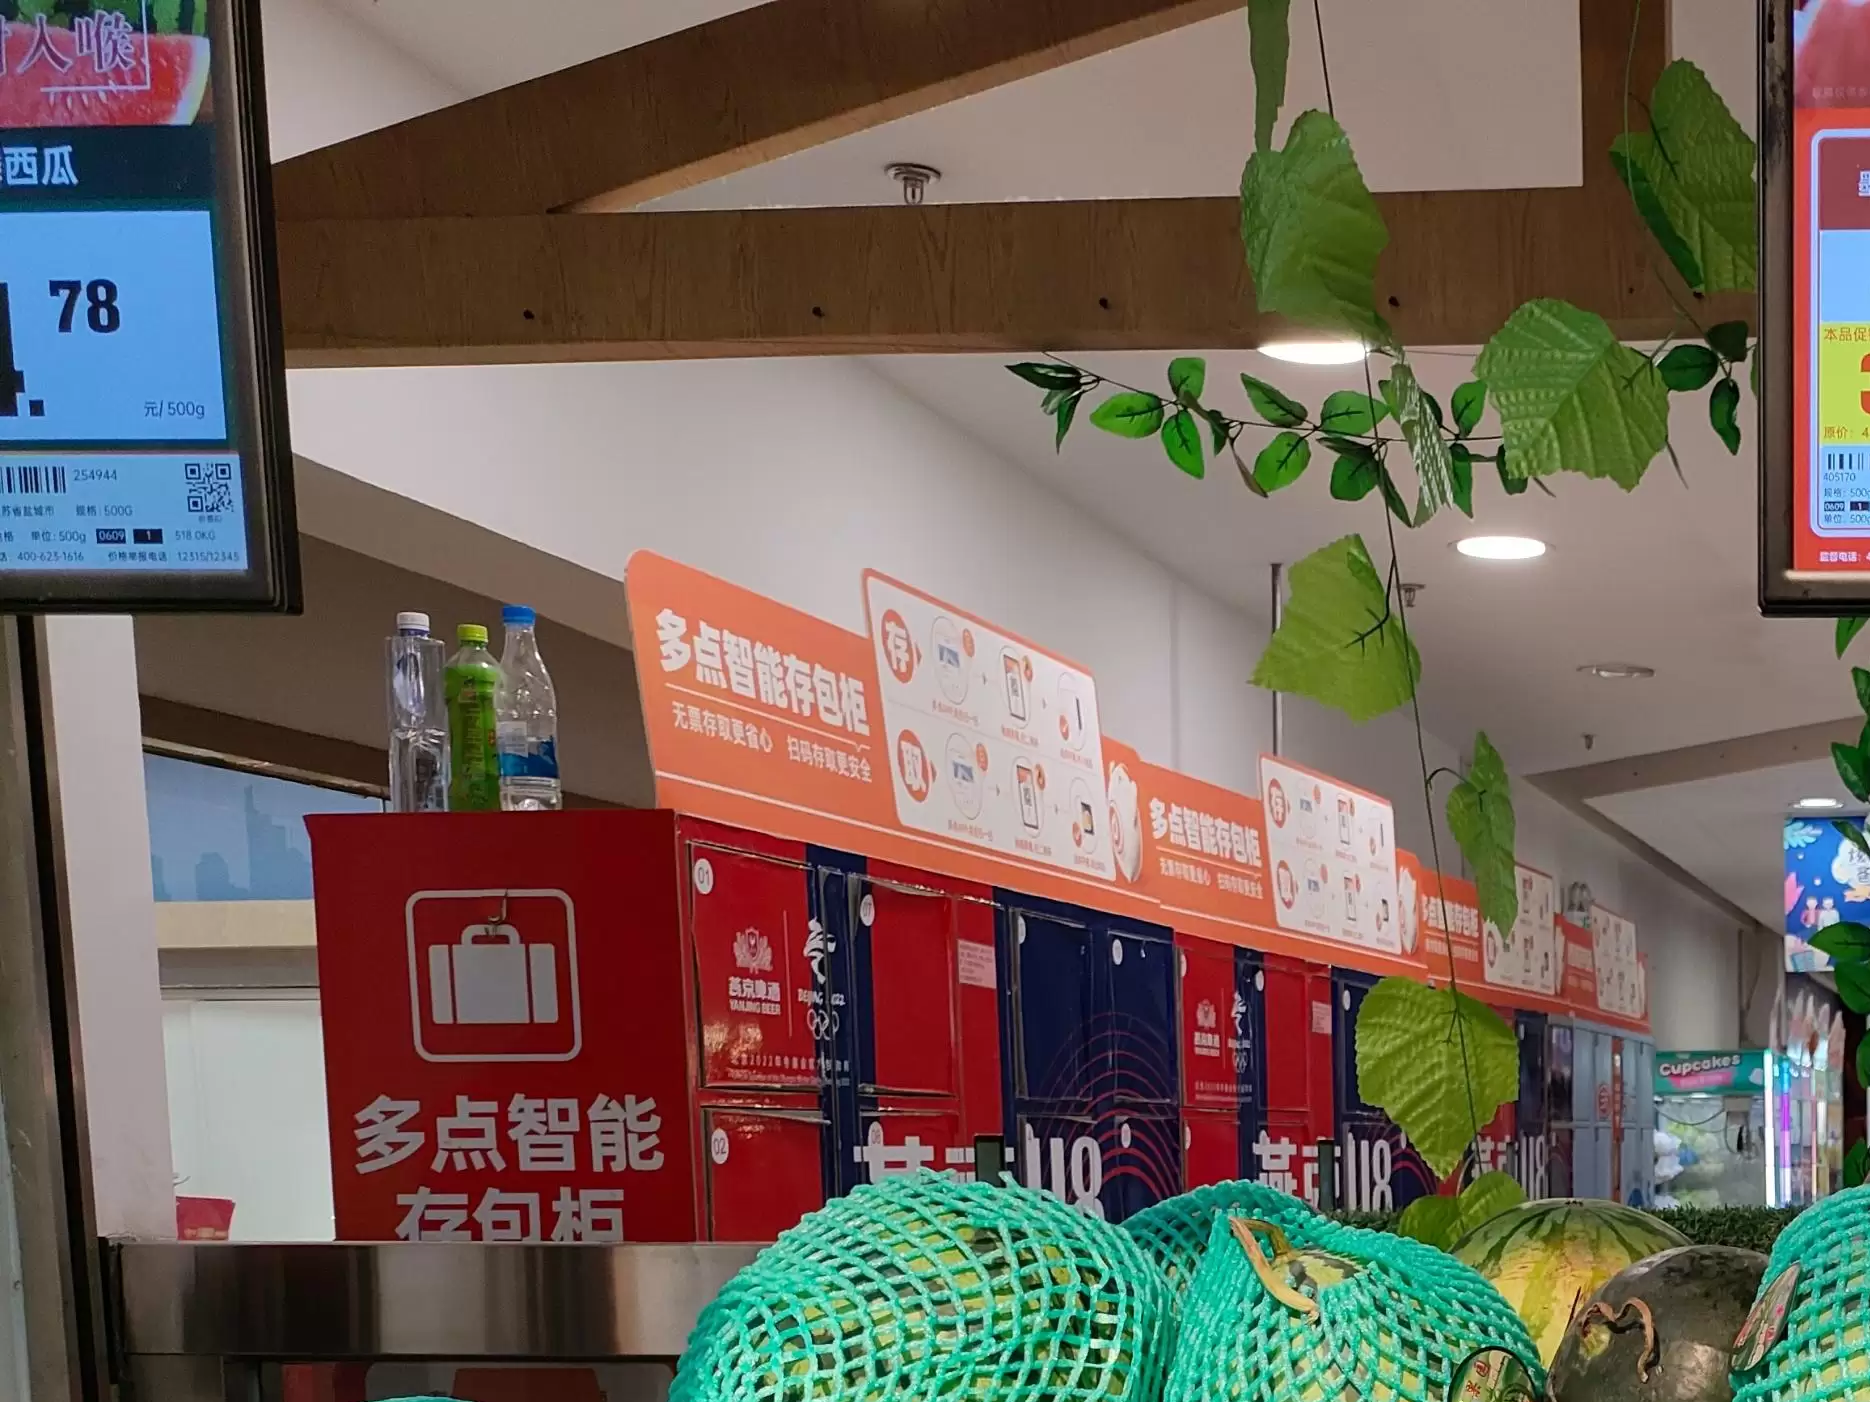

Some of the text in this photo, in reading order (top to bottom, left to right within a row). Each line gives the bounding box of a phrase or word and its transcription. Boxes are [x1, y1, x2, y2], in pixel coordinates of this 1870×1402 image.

[0, 9, 136, 74] 人喉
[0, 146, 79, 186] 西瓜
[73, 469, 118, 481] 254944
[1823, 473, 1856, 482] 405170
[1824, 502, 1845, 511] 0609
[17, 552, 84, 562] 400-623-1616
[97, 531, 126, 543] 0609
[884, 620, 910, 674] 存
[655, 607, 870, 737] 多点智能存包柜
[671, 700, 873, 783] 无票存取更省心 扫码存取更安全
[1659, 1054, 1741, 1077] Cupcakes
[353, 1093, 665, 1174] 多点智能
[395, 1186, 625, 1241] 存包柜
